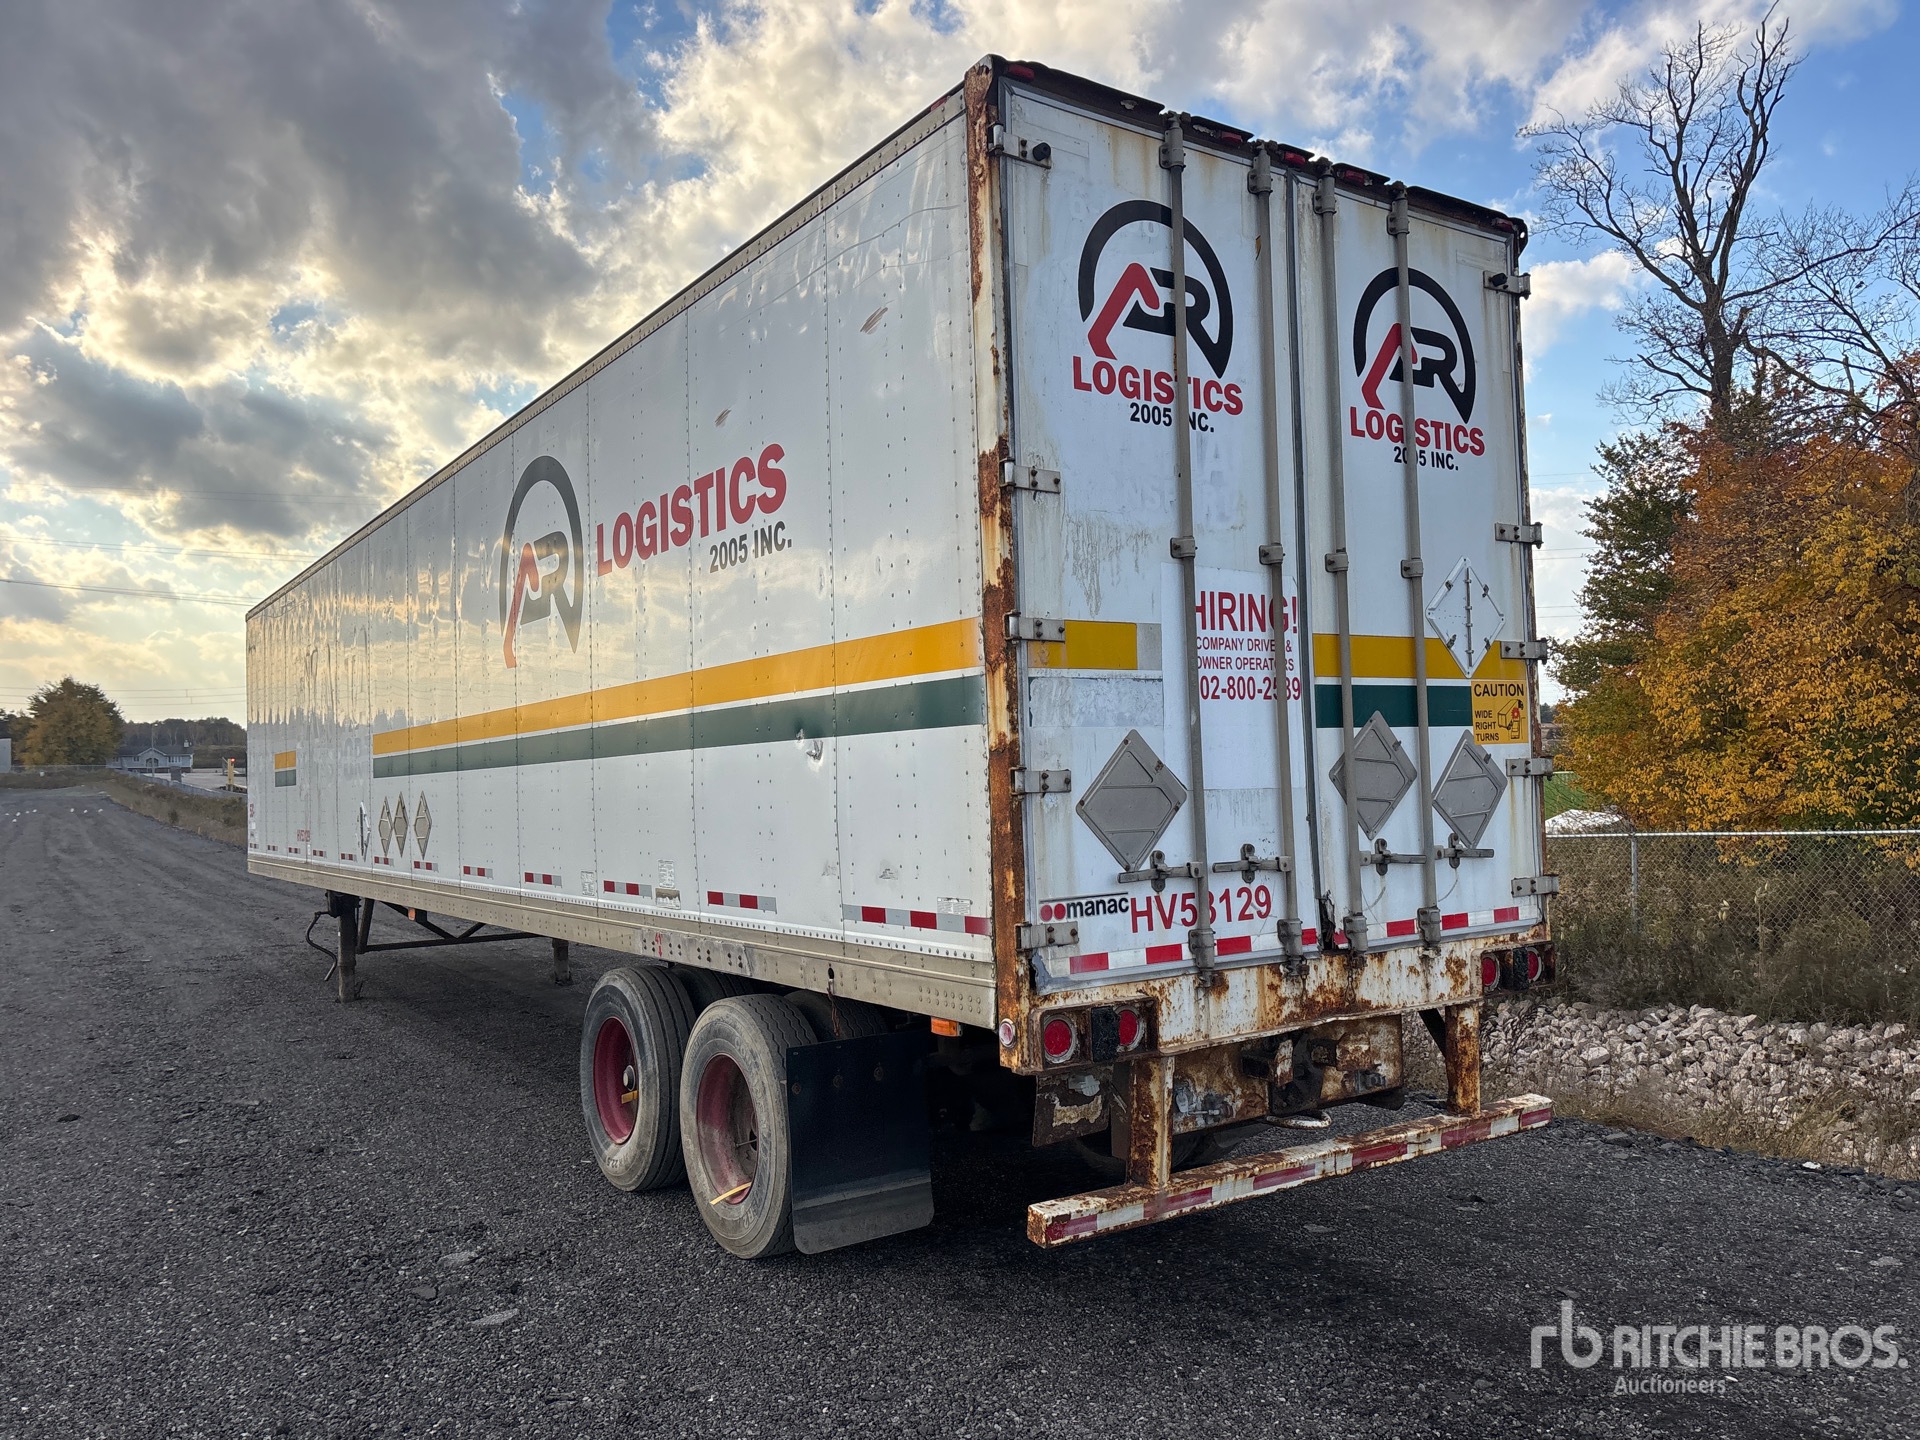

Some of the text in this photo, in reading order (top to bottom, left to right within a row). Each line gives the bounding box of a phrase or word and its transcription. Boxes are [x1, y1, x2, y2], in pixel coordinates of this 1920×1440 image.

[1073, 355, 1243, 416] LOGISICS
[1129, 402, 1215, 433] 2005 NC.
[1350, 406, 1486, 457] LOGSTICS
[1430, 451, 1459, 471] INC.
[596, 443, 787, 577] LOGISTICS
[709, 520, 792, 574] 2005 INC.
[1196, 636, 1244, 652] COMPANY
[1247, 638, 1277, 652] DRIVE
[1197, 656, 1233, 670] OWNER
[1474, 683, 1525, 697] CAUTION
[1474, 710, 1493, 719] WIDE
[1475, 721, 1496, 730] RIGHT
[1475, 732, 1500, 742] TURNS
[1066, 897, 1130, 918] manac
